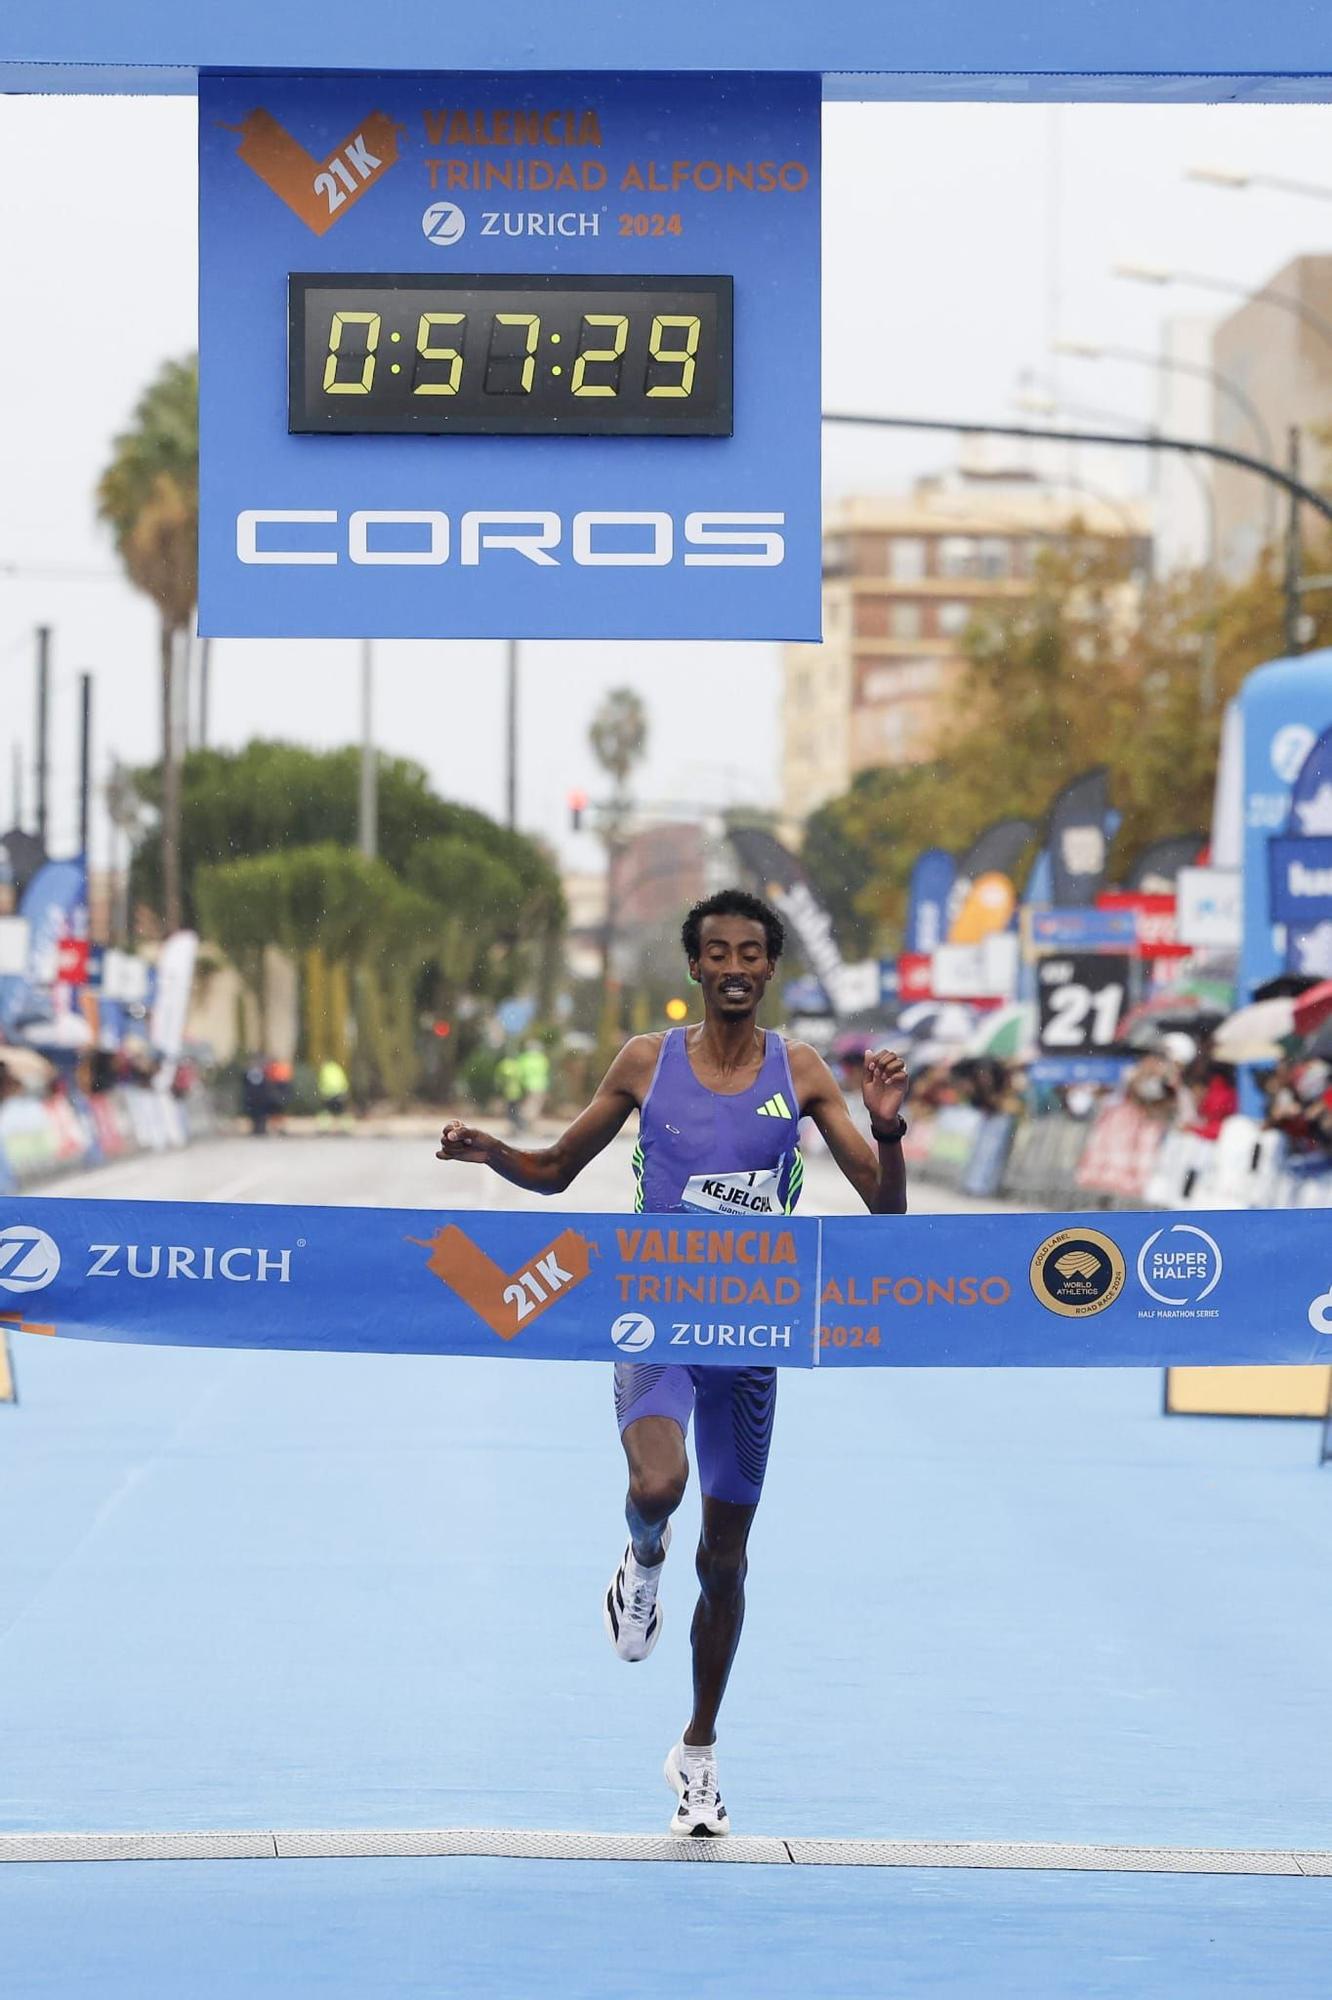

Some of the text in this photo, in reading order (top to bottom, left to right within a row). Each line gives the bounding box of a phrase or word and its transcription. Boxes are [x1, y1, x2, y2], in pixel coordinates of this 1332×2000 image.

[422, 110, 603, 146] VALENCIA
[314, 134, 382, 214] 21K
[424, 159, 810, 192] TRINIDAD ALFONSO
[480, 212, 600, 236] ZURICH
[617, 213, 682, 237] 2024
[322, 311, 701, 398] 0:57:29
[236, 510, 785, 567] COROS
[1042, 982, 1124, 1046] 21
[747, 1172, 756, 1187] 1
[615, 1228, 797, 1264] VALENCIA
[1035, 1233, 1071, 1267] GOLD LABEL
[1153, 1252, 1207, 1265] SUPER
[86, 1244, 293, 1283] ZURICH
[1152, 1266, 1207, 1279] HALFS
[503, 1250, 574, 1321] 21K
[615, 1274, 1011, 1306] TRINIDAD ALFONSO
[1075, 1305, 1098, 1314] ROAD
[1097, 1291, 1115, 1307] RACE
[1137, 1309, 1220, 1318] HALF MARATHON SERIES
[669, 1323, 792, 1348] ZURICH
[814, 1325, 881, 1348] 2024
